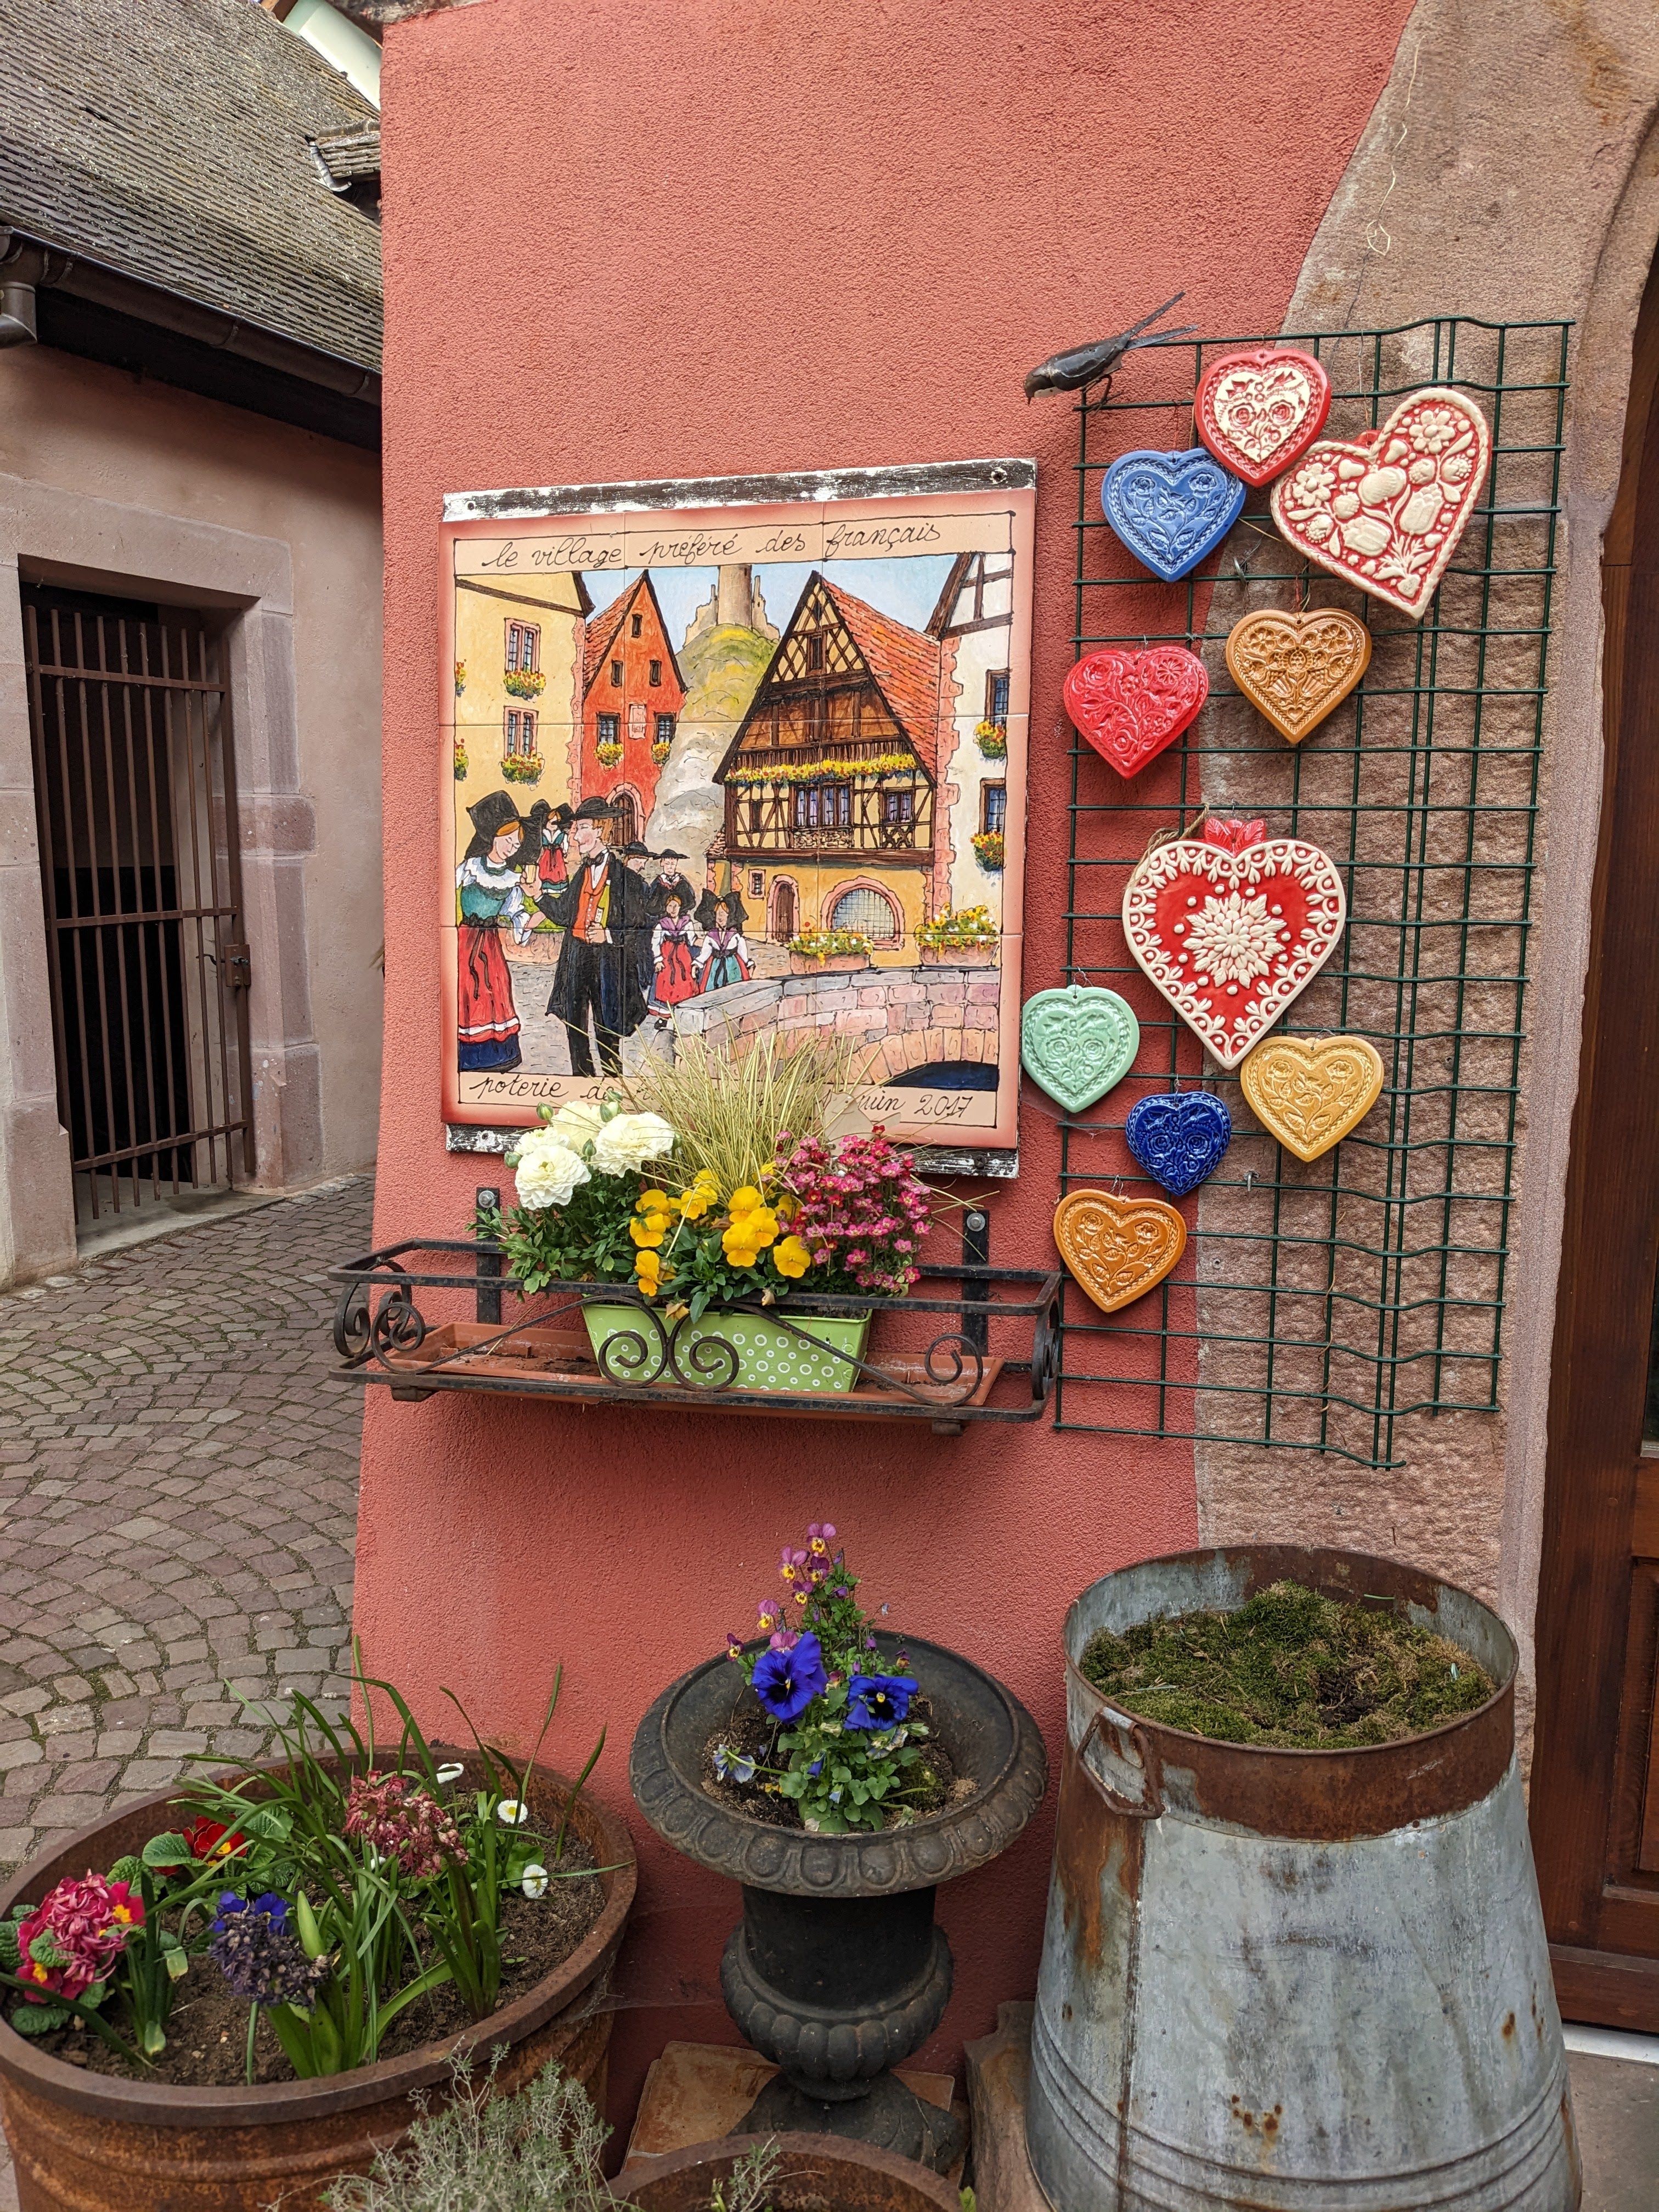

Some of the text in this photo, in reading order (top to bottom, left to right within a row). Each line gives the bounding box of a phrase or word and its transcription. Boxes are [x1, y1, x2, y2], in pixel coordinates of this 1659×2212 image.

[481, 522, 941, 568] le village préféré des français
[469, 1074, 570, 1099] poterie
[913, 1093, 974, 1118] 2017
